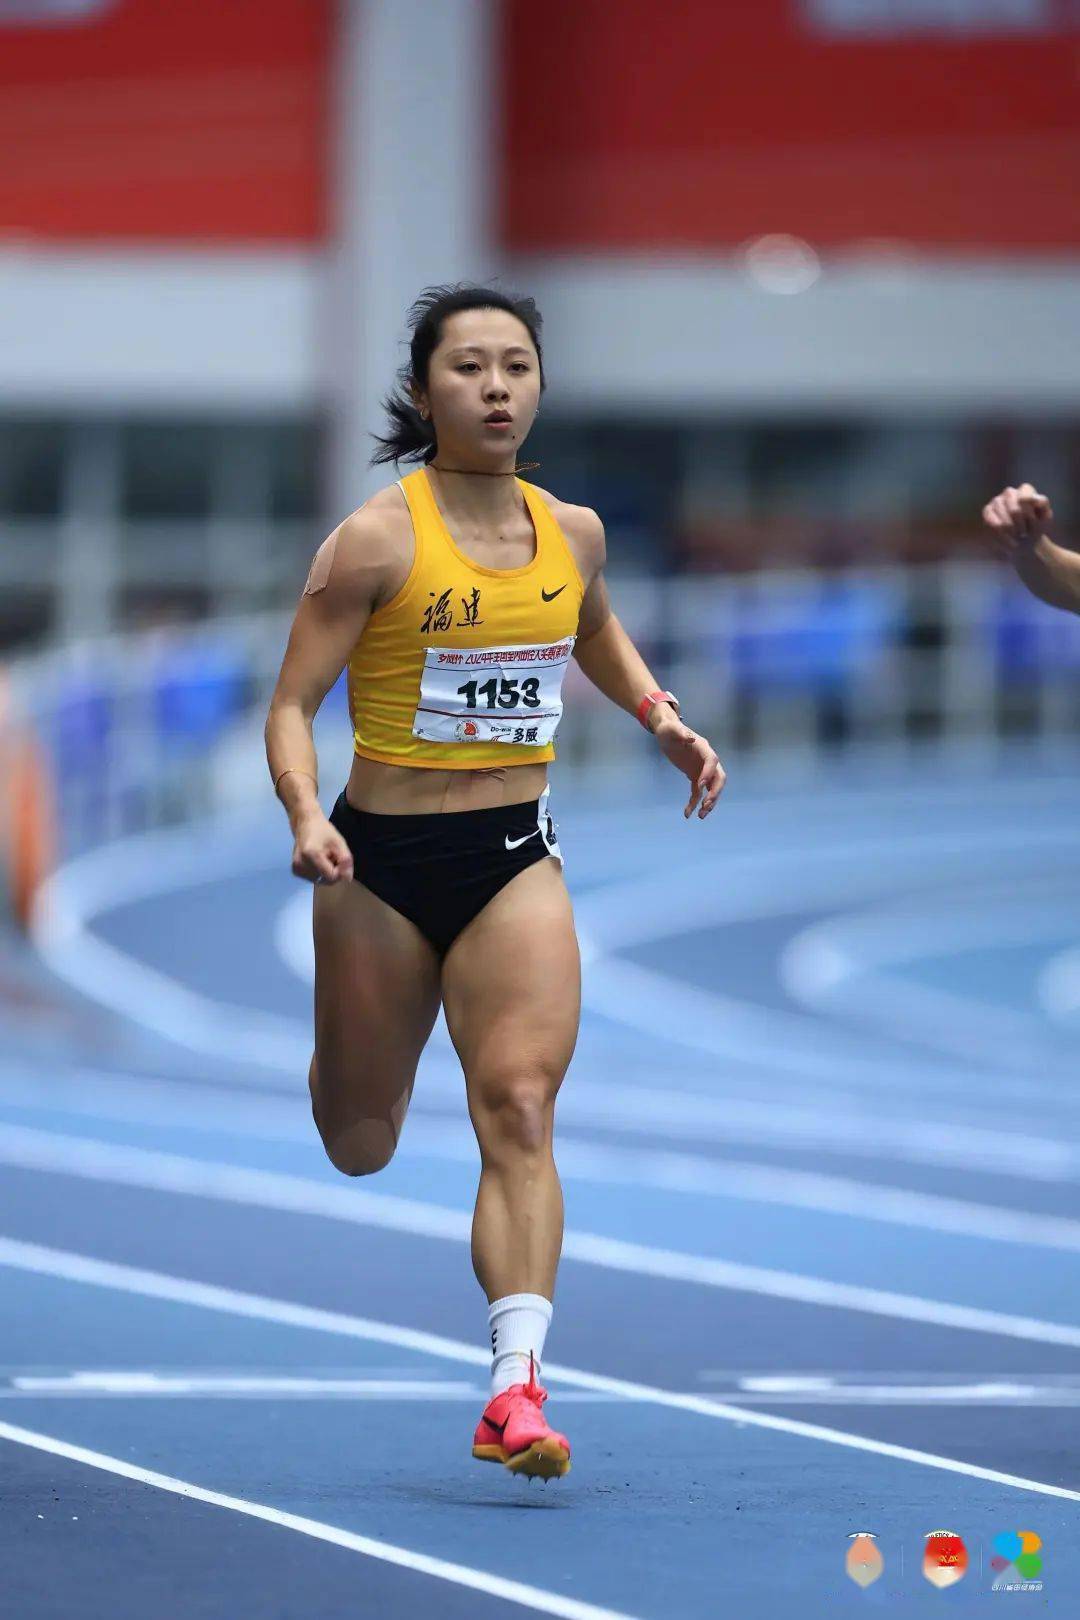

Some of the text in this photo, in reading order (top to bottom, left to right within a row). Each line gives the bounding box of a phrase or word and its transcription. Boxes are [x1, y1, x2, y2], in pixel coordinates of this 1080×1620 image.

[421, 587, 484, 634] 福建
[457, 677, 541, 709] 1153
[512, 727, 538, 743] 多威
